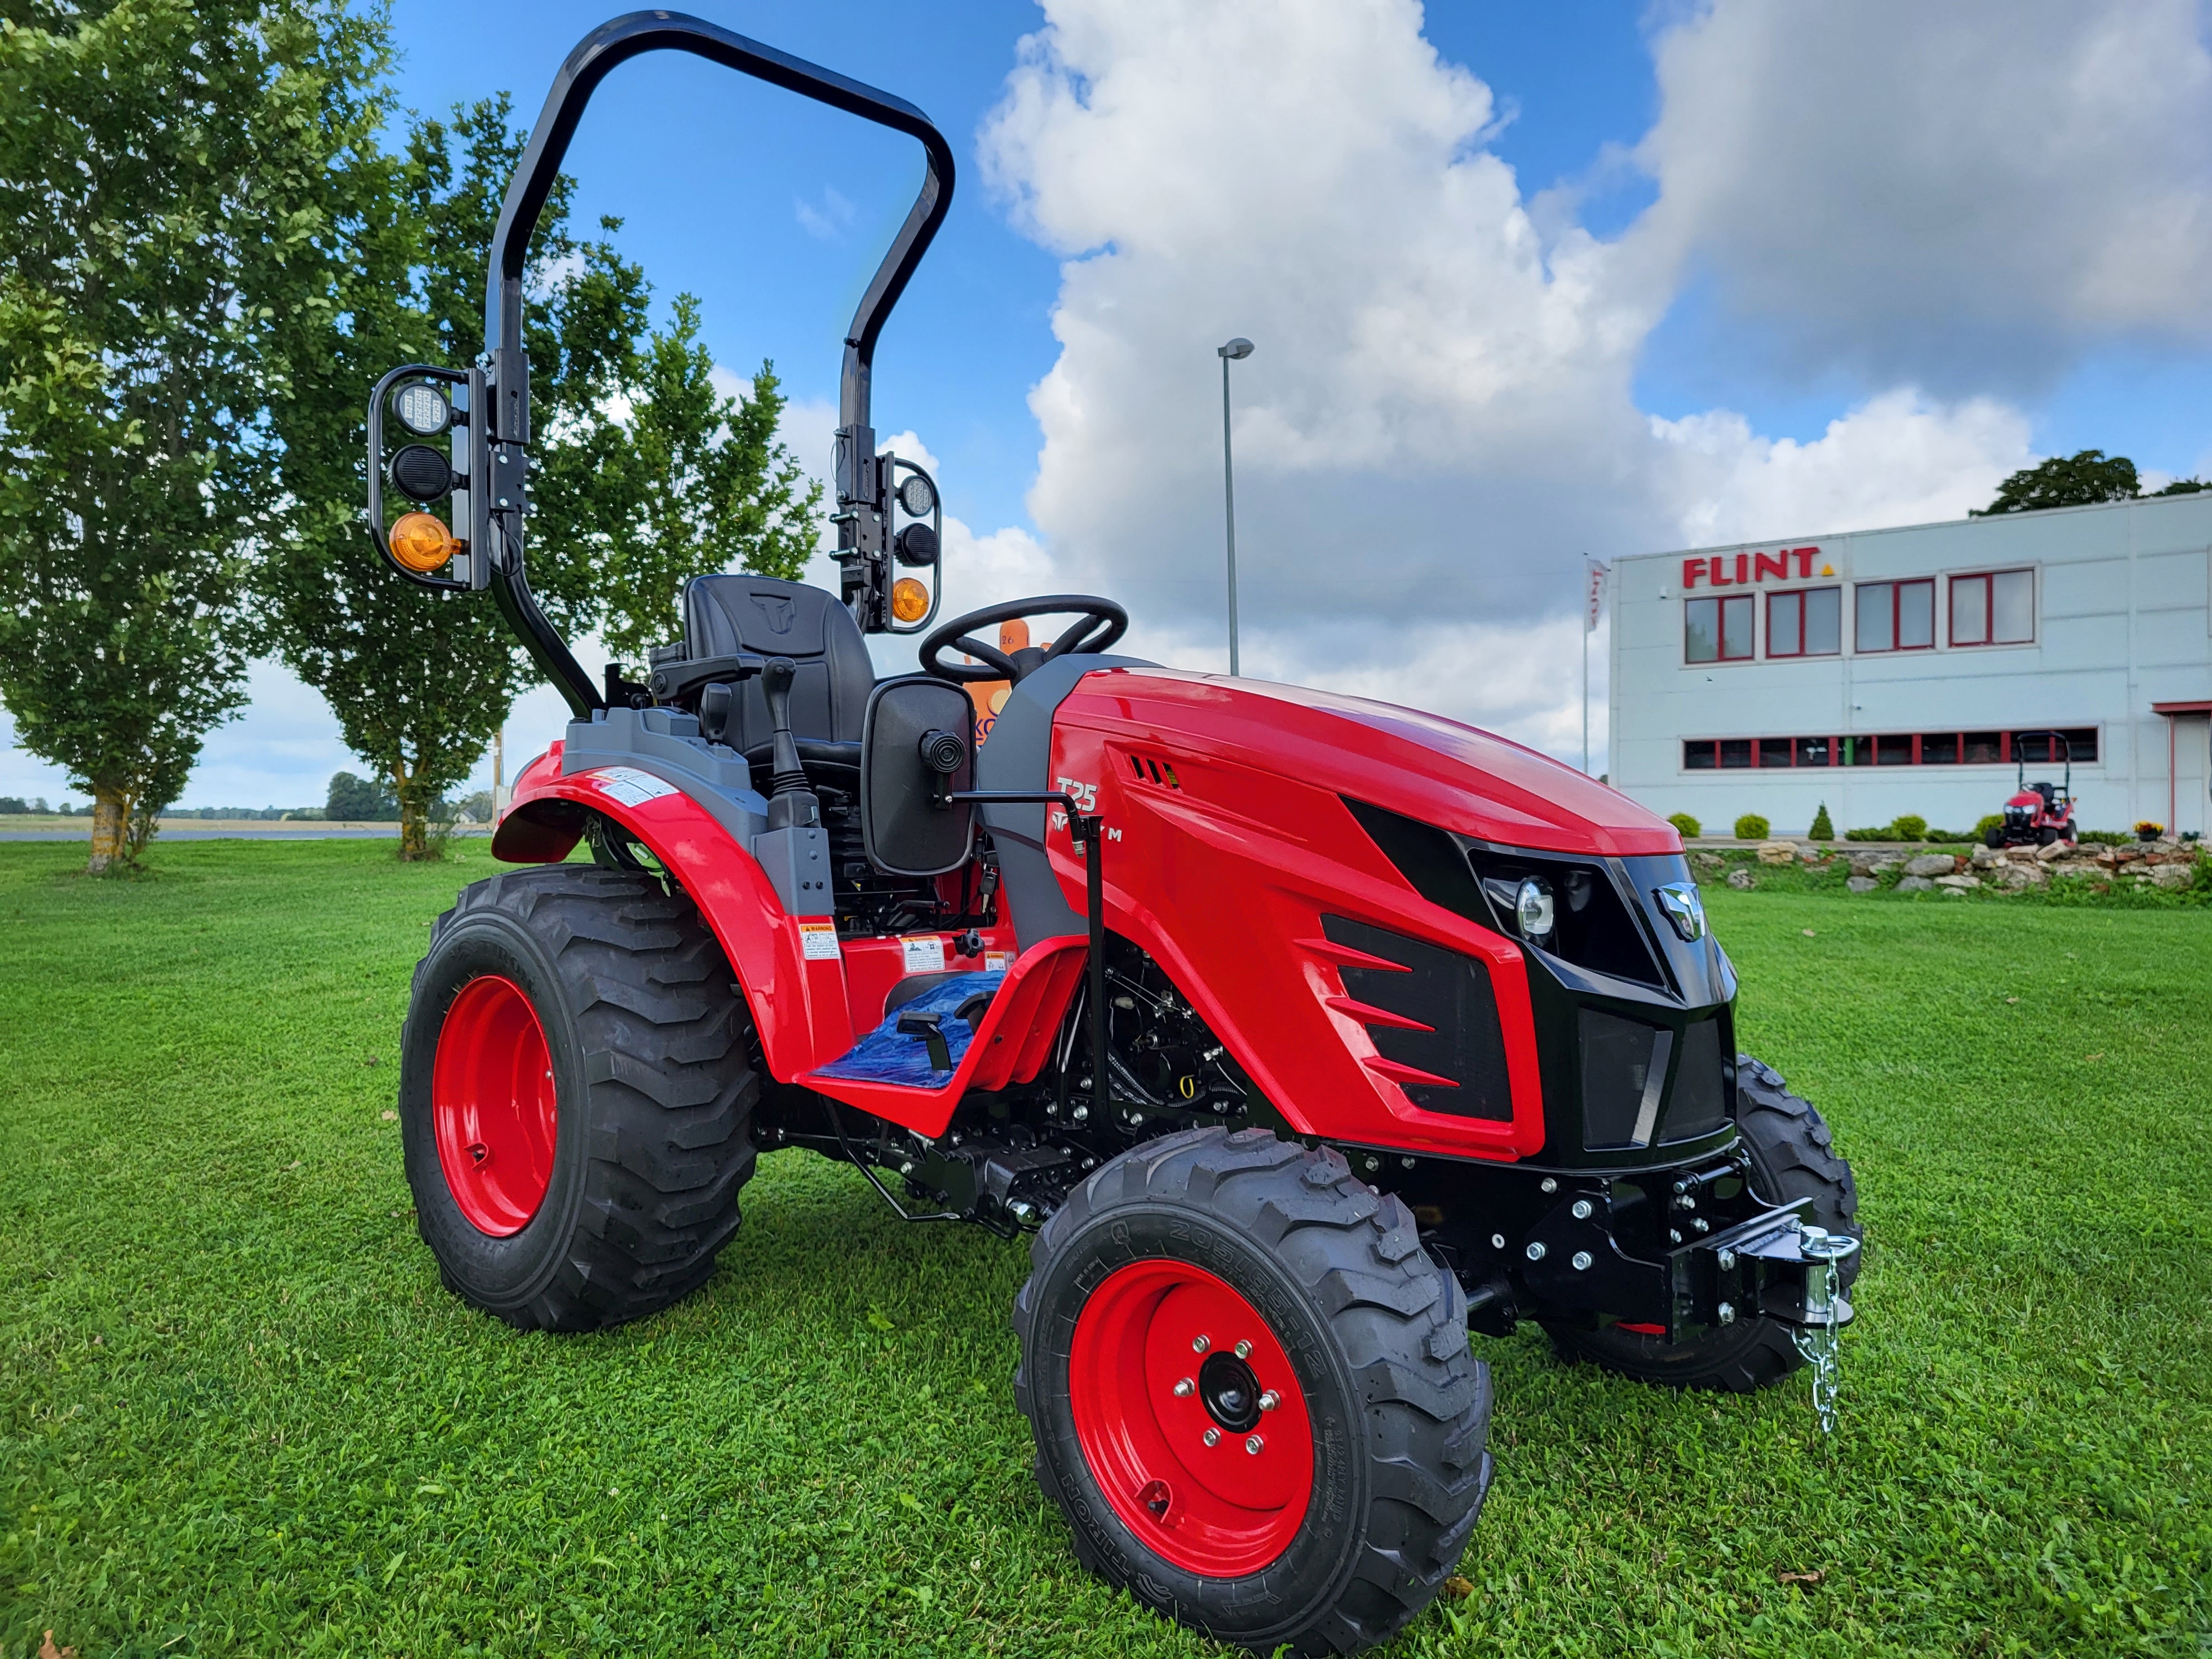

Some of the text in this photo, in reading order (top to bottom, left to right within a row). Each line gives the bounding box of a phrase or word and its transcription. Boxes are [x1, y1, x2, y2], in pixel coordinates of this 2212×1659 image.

[1683, 546, 1821, 588] FLINT
[1001, 635, 1014, 645] 26
[1057, 776, 1098, 812] T25
[1061, 1473, 1130, 1577] TIRON
